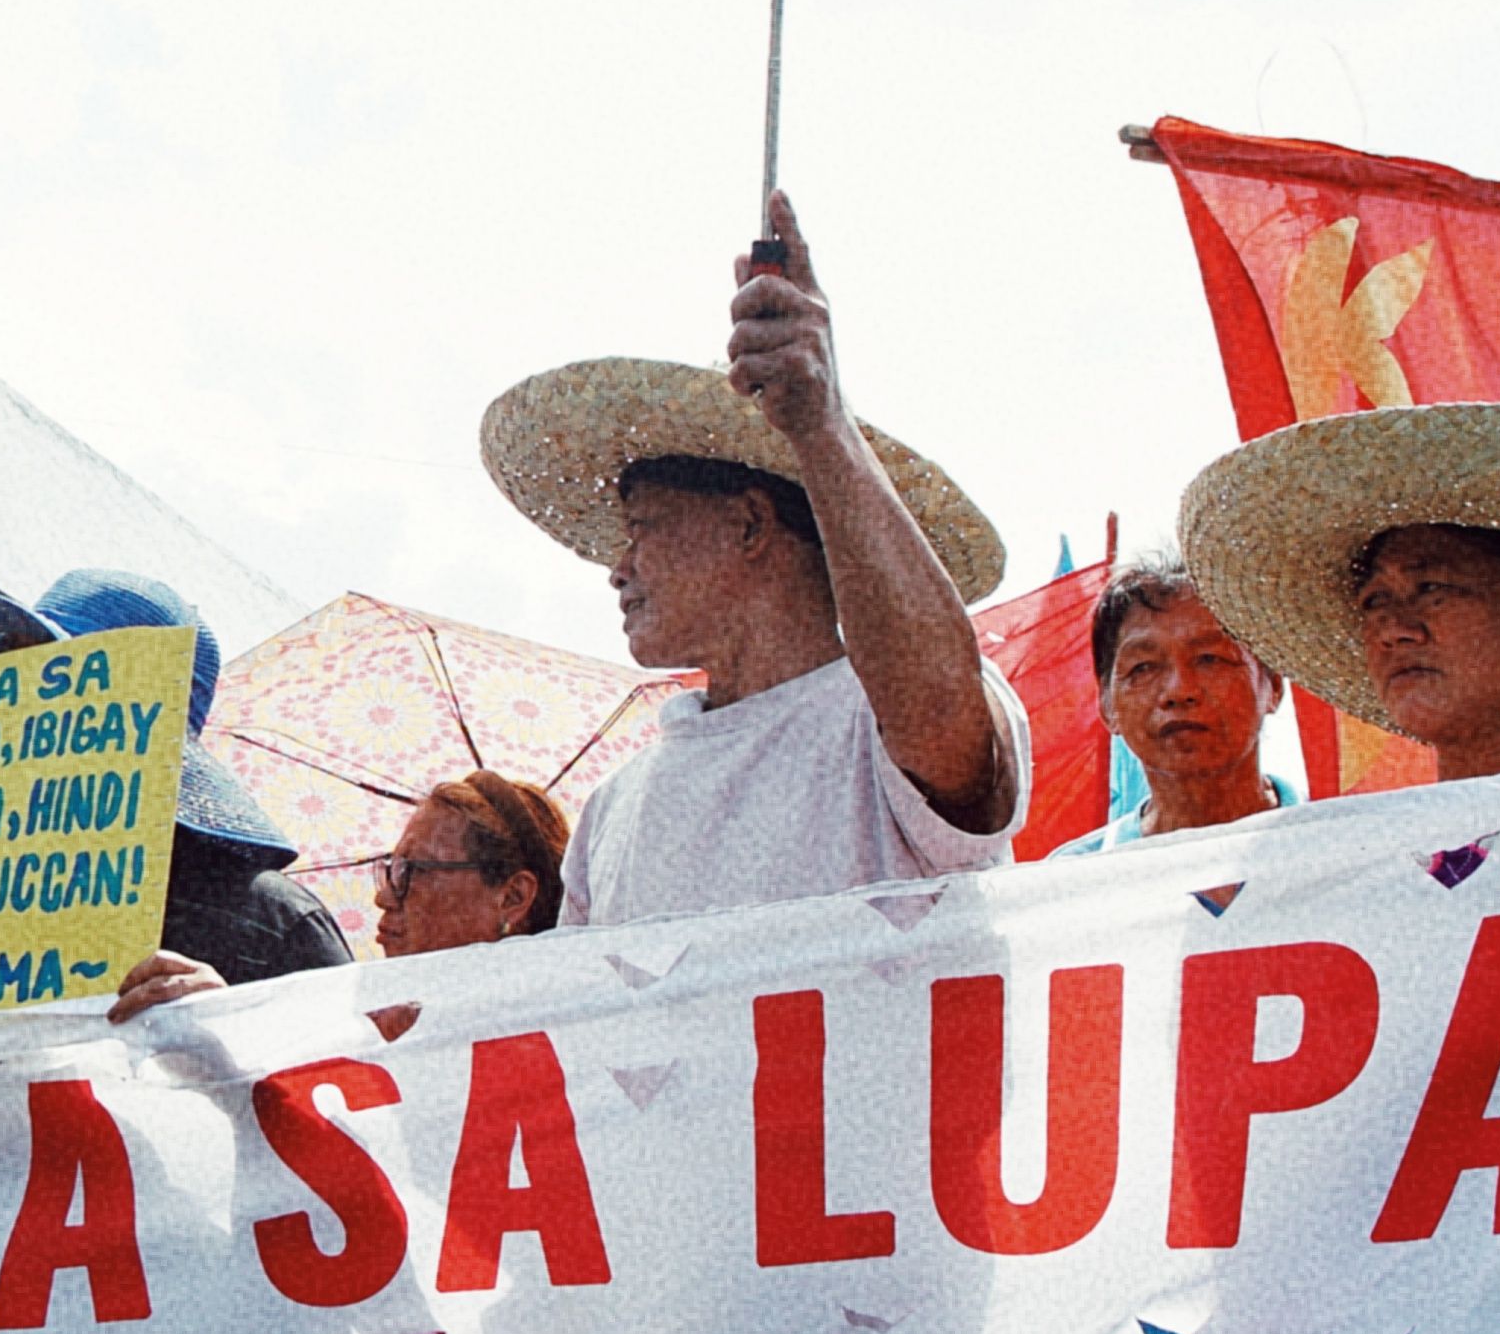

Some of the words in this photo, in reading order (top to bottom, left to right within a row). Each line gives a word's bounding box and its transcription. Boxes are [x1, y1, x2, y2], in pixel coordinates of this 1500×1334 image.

[38, 650, 110, 698] SA
[18, 701, 162, 761] IBIGAY
[25, 770, 141, 835] HINDI
[253, 1031, 612, 1307] SA
